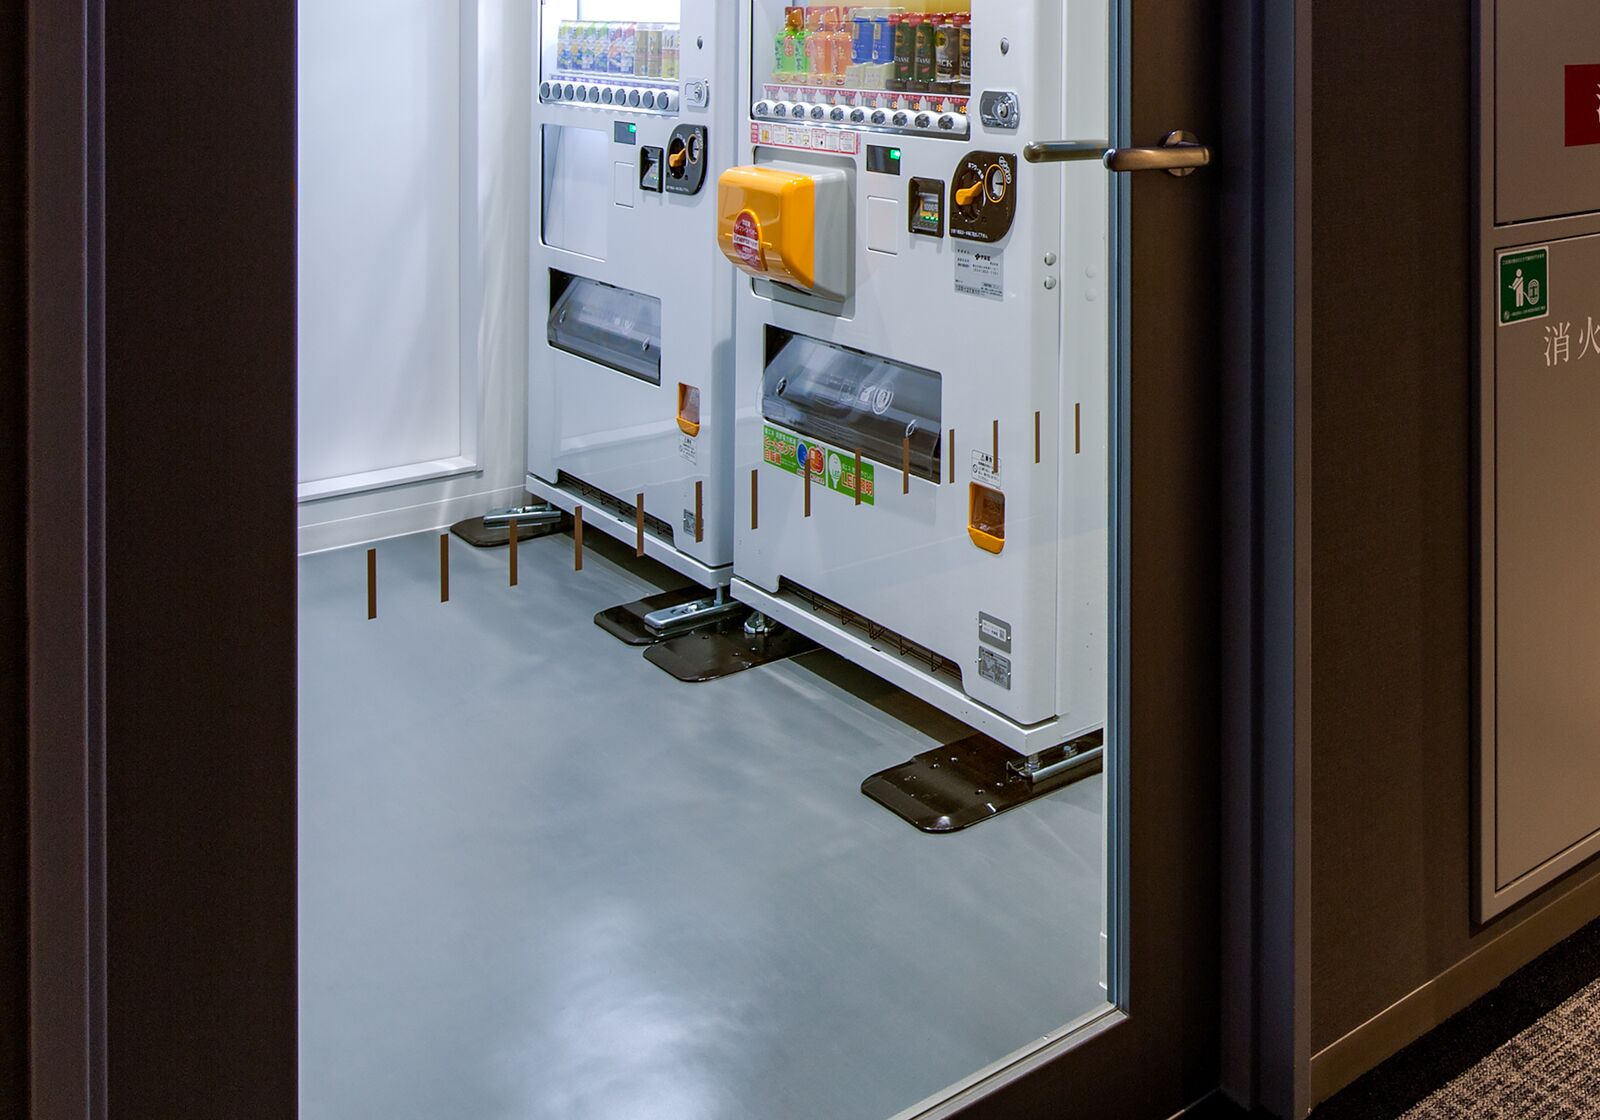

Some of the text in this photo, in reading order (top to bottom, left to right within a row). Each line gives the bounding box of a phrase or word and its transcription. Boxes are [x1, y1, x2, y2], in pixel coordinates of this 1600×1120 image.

[764, 436, 796, 458] ヒートポンプ
